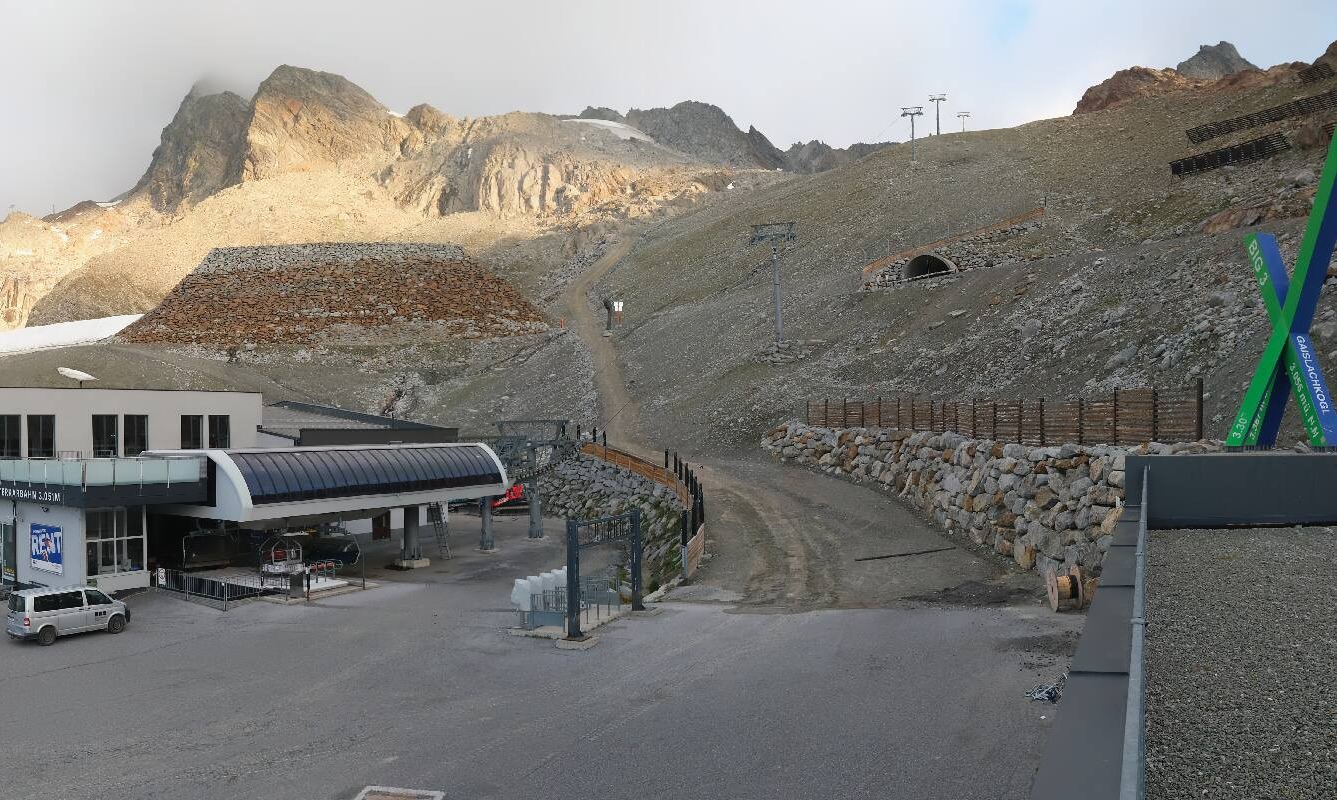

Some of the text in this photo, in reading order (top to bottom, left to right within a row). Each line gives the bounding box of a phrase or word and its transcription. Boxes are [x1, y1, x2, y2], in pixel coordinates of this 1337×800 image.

[1248, 239, 1268, 286] BIG 3
[1296, 335, 1330, 415] GAISLACHKOGL
[31, 532, 62, 556] RENT
